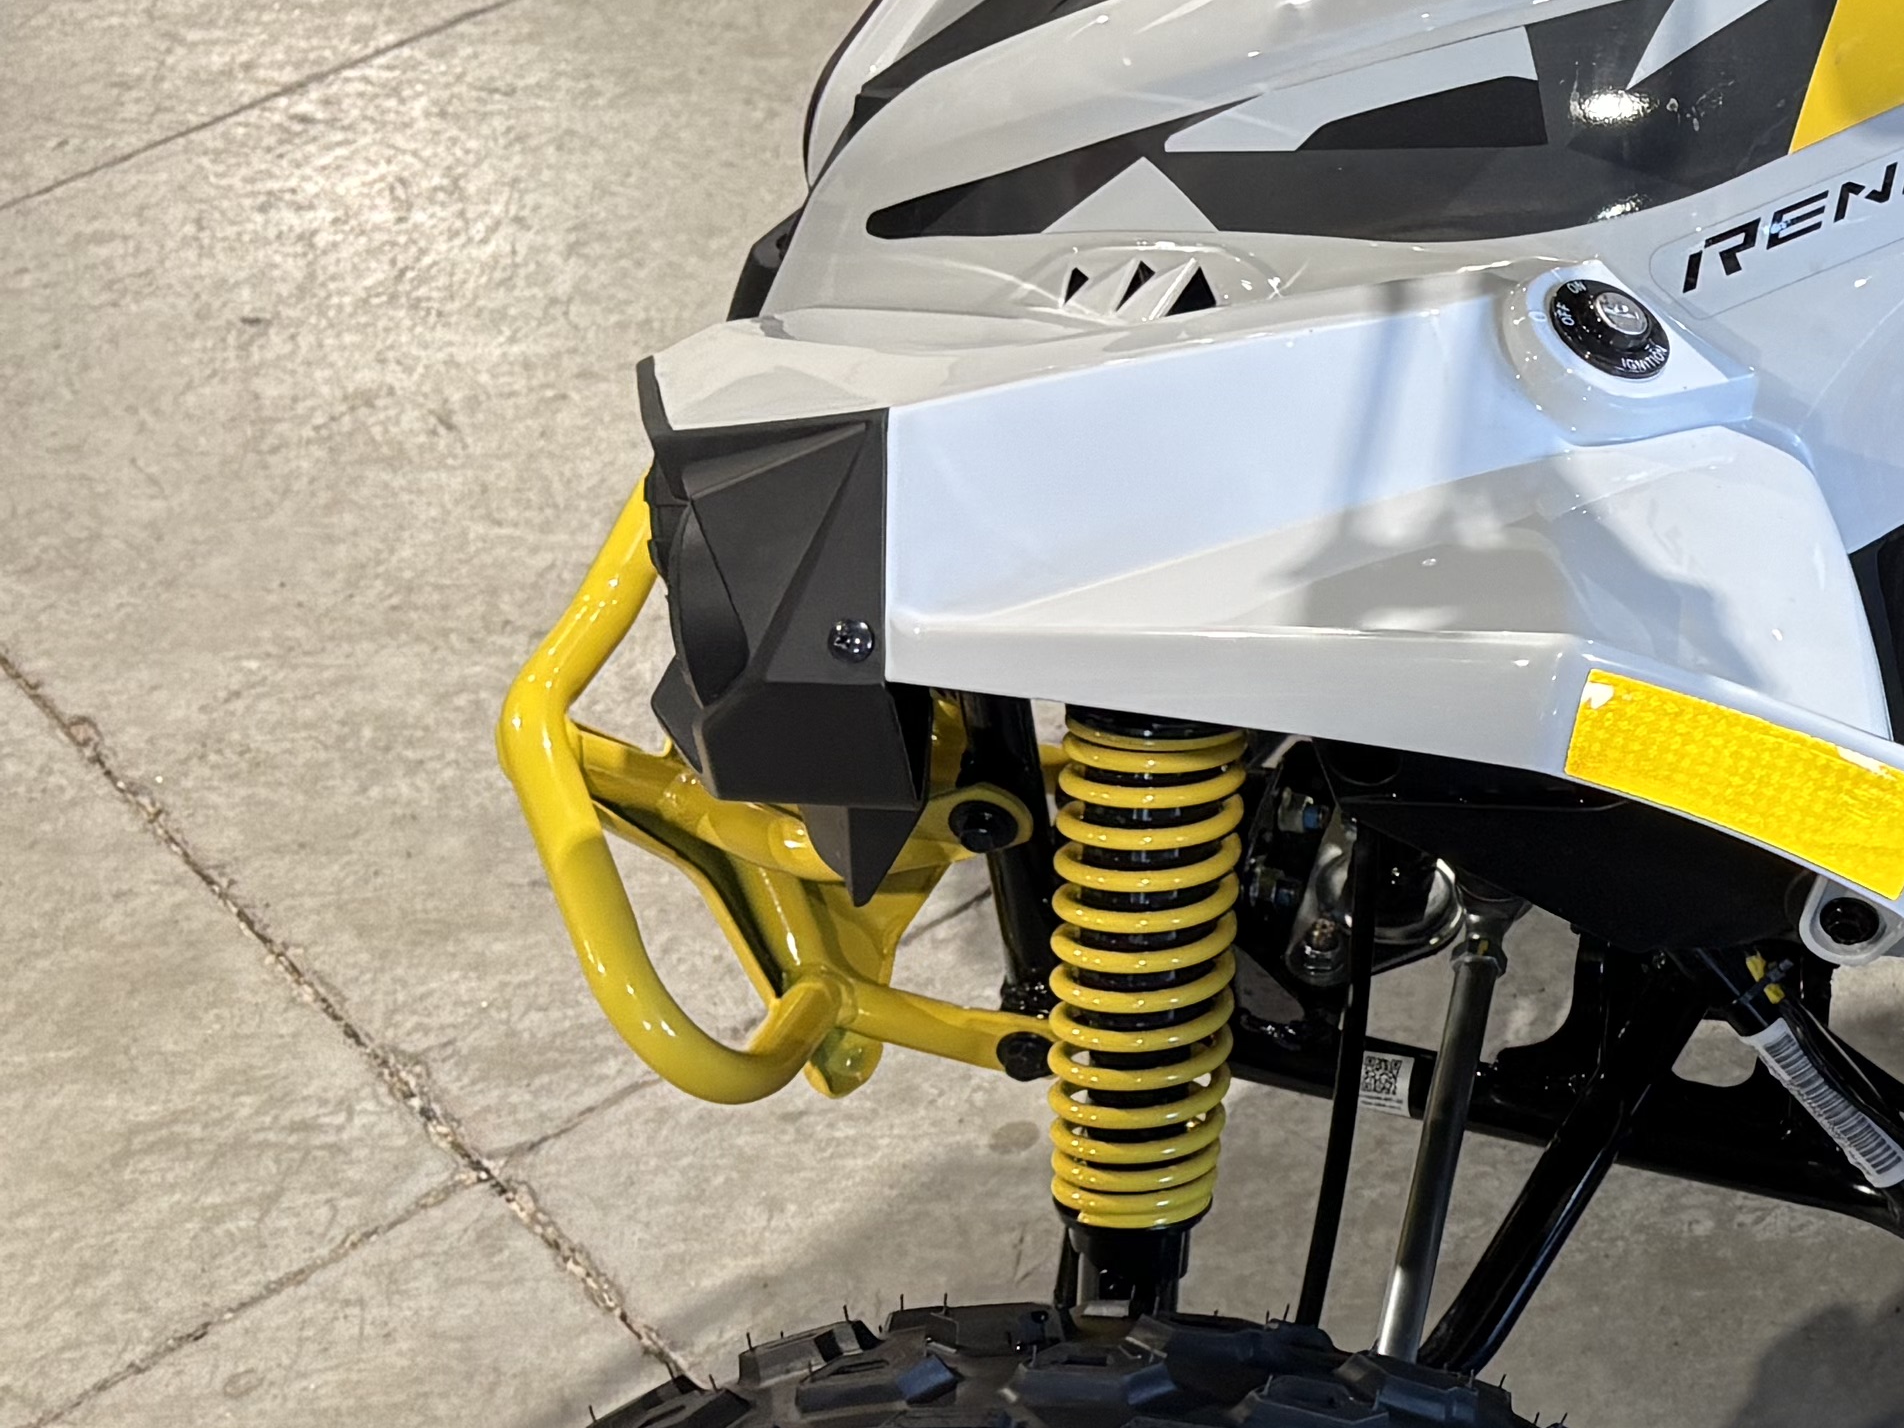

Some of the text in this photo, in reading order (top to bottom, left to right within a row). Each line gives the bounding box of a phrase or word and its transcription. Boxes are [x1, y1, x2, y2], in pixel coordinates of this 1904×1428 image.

[1566, 281, 1588, 295] ON
[1555, 302, 1576, 326] OFF
[1621, 342, 1668, 372] IGNITION
